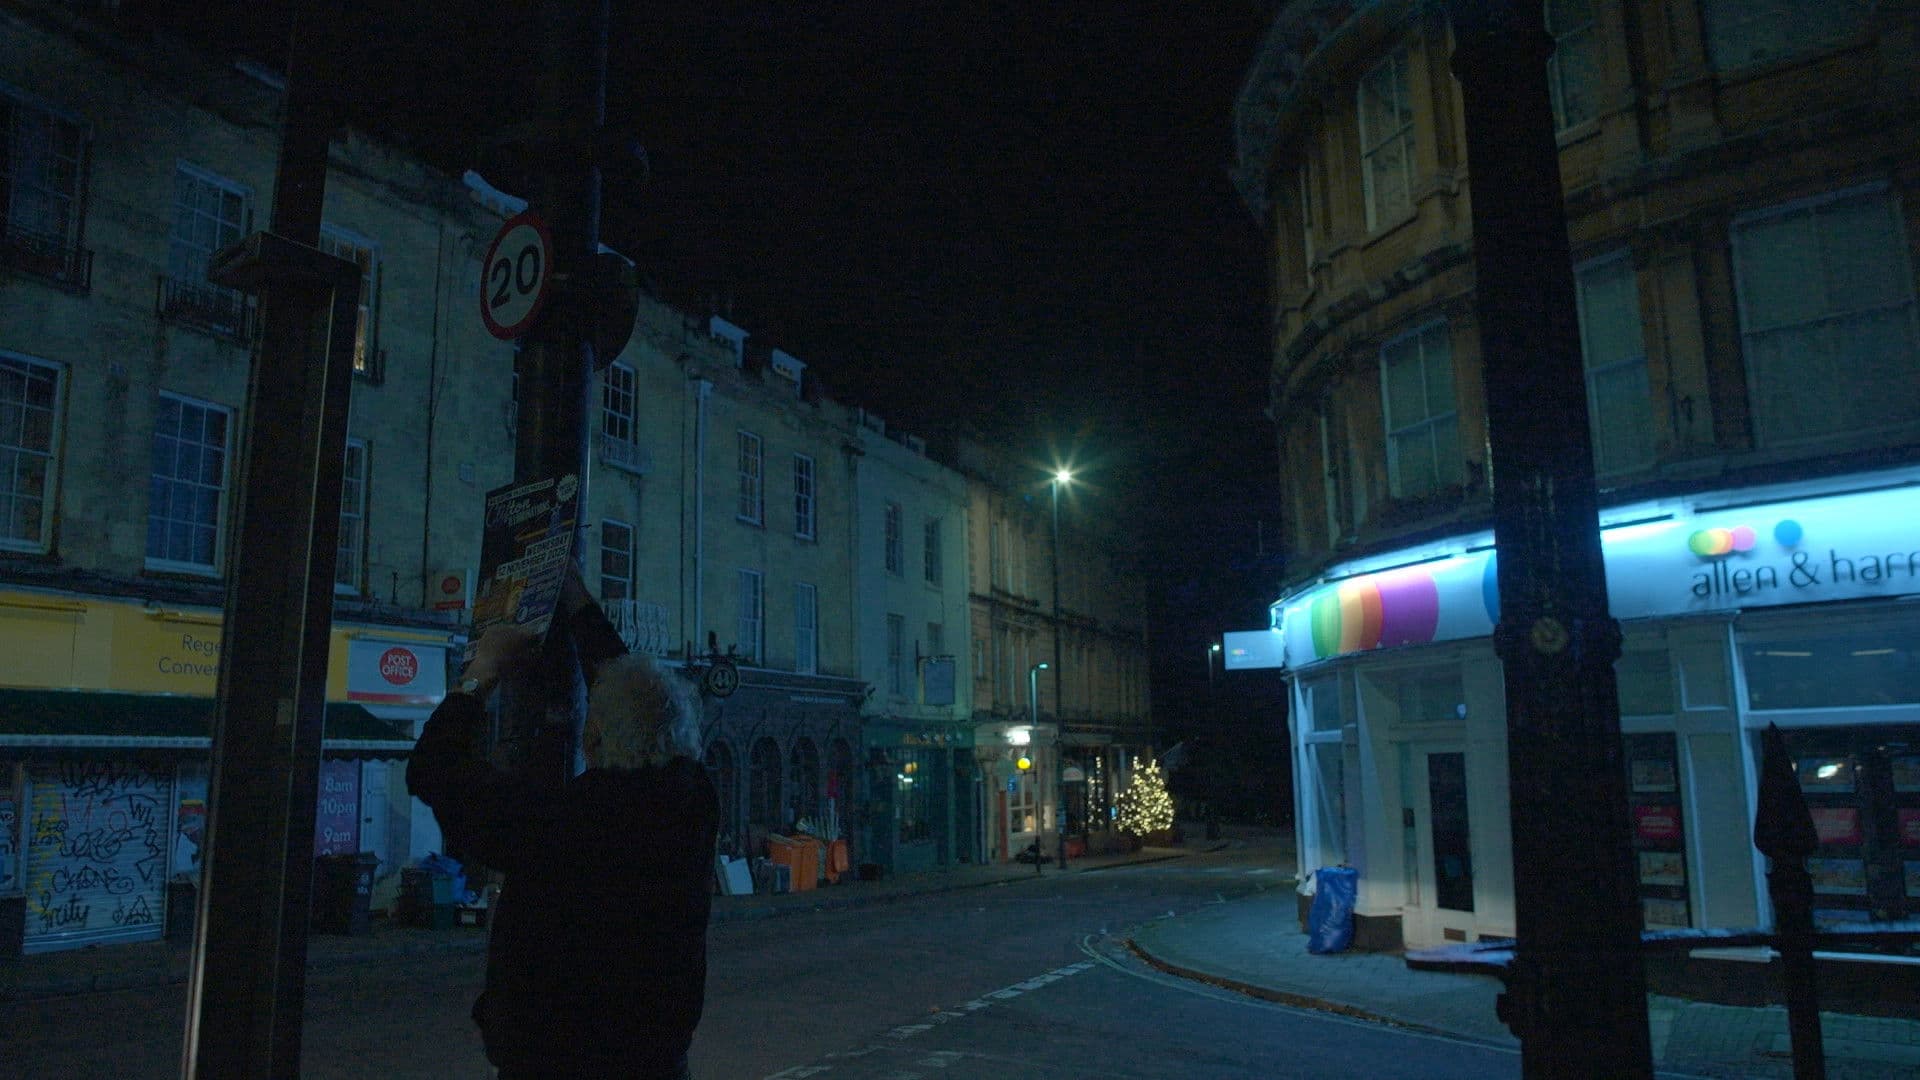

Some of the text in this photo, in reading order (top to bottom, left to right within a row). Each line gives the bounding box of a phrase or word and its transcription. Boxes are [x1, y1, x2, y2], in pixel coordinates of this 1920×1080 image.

[491, 244, 540, 309] 20
[1693, 559, 1777, 597] allen
[1789, 551, 1820, 588] &
[388, 654, 411, 666] POST
[382, 664, 414, 678] OFFICE
[325, 777, 353, 793] 8am
[321, 798, 356, 816] 10pm
[323, 827, 352, 843] 9am
